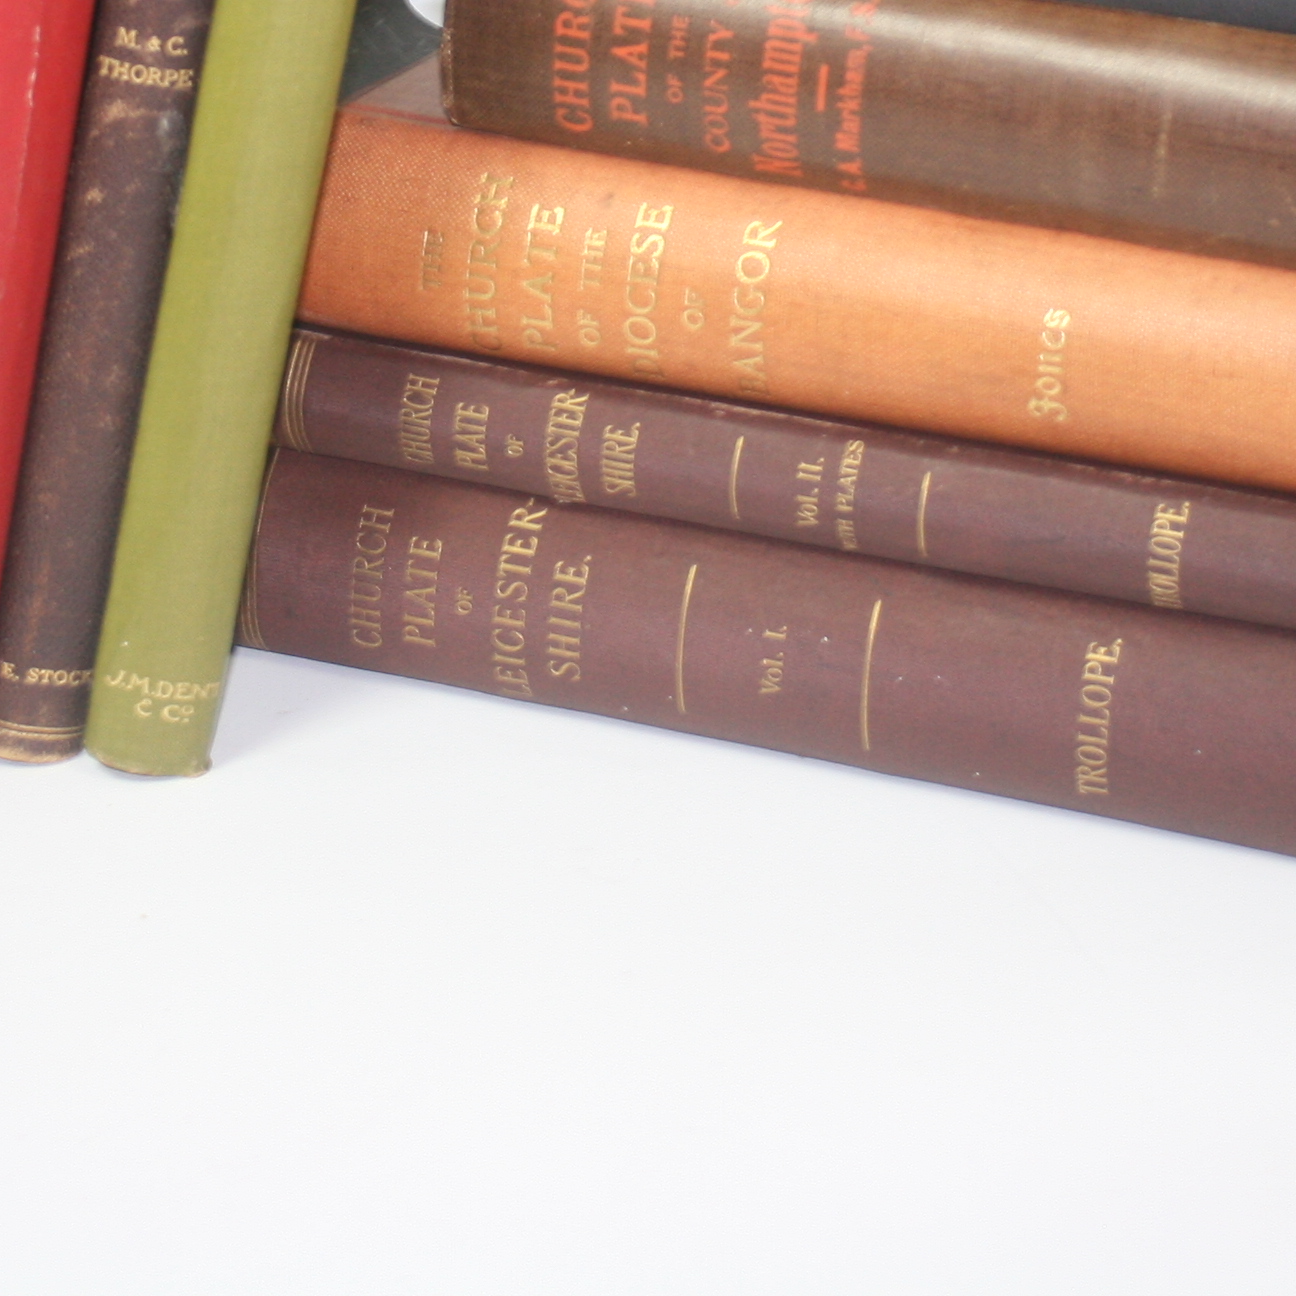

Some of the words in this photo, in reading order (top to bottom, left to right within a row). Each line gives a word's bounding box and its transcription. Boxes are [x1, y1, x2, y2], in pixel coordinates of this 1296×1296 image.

[146, 35, 162, 52] &
[668, 14, 689, 59] THE
[97, 54, 194, 91] THORPE
[666, 75, 684, 103] OF
[704, 19, 734, 153] COUNTY
[420, 228, 445, 290] THE
[463, 172, 515, 352] CHURCH
[521, 202, 566, 352] PLATE
[580, 228, 609, 291] THE
[623, 202, 675, 377] DIOCESE
[579, 309, 602, 346] OF
[682, 287, 706, 330] OF
[729, 219, 784, 395] BANGOR
[398, 373, 440, 464] CHURCH
[454, 402, 489, 470] PLATE
[504, 434, 524, 457] OF
[599, 422, 640, 496] SHIRE.
[835, 440, 865, 512] PLATES
[795, 488, 820, 526] Vol.
[348, 504, 394, 649] CHURCH
[402, 536, 443, 647] PLATE
[454, 587, 474, 614] OF
[491, 497, 547, 696] LEICESTER-
[546, 555, 592, 681] SHIRE.
[763, 625, 788, 640] I.
[759, 652, 785, 695] Vol.
[1075, 638, 1123, 795] TROLLOPE.
